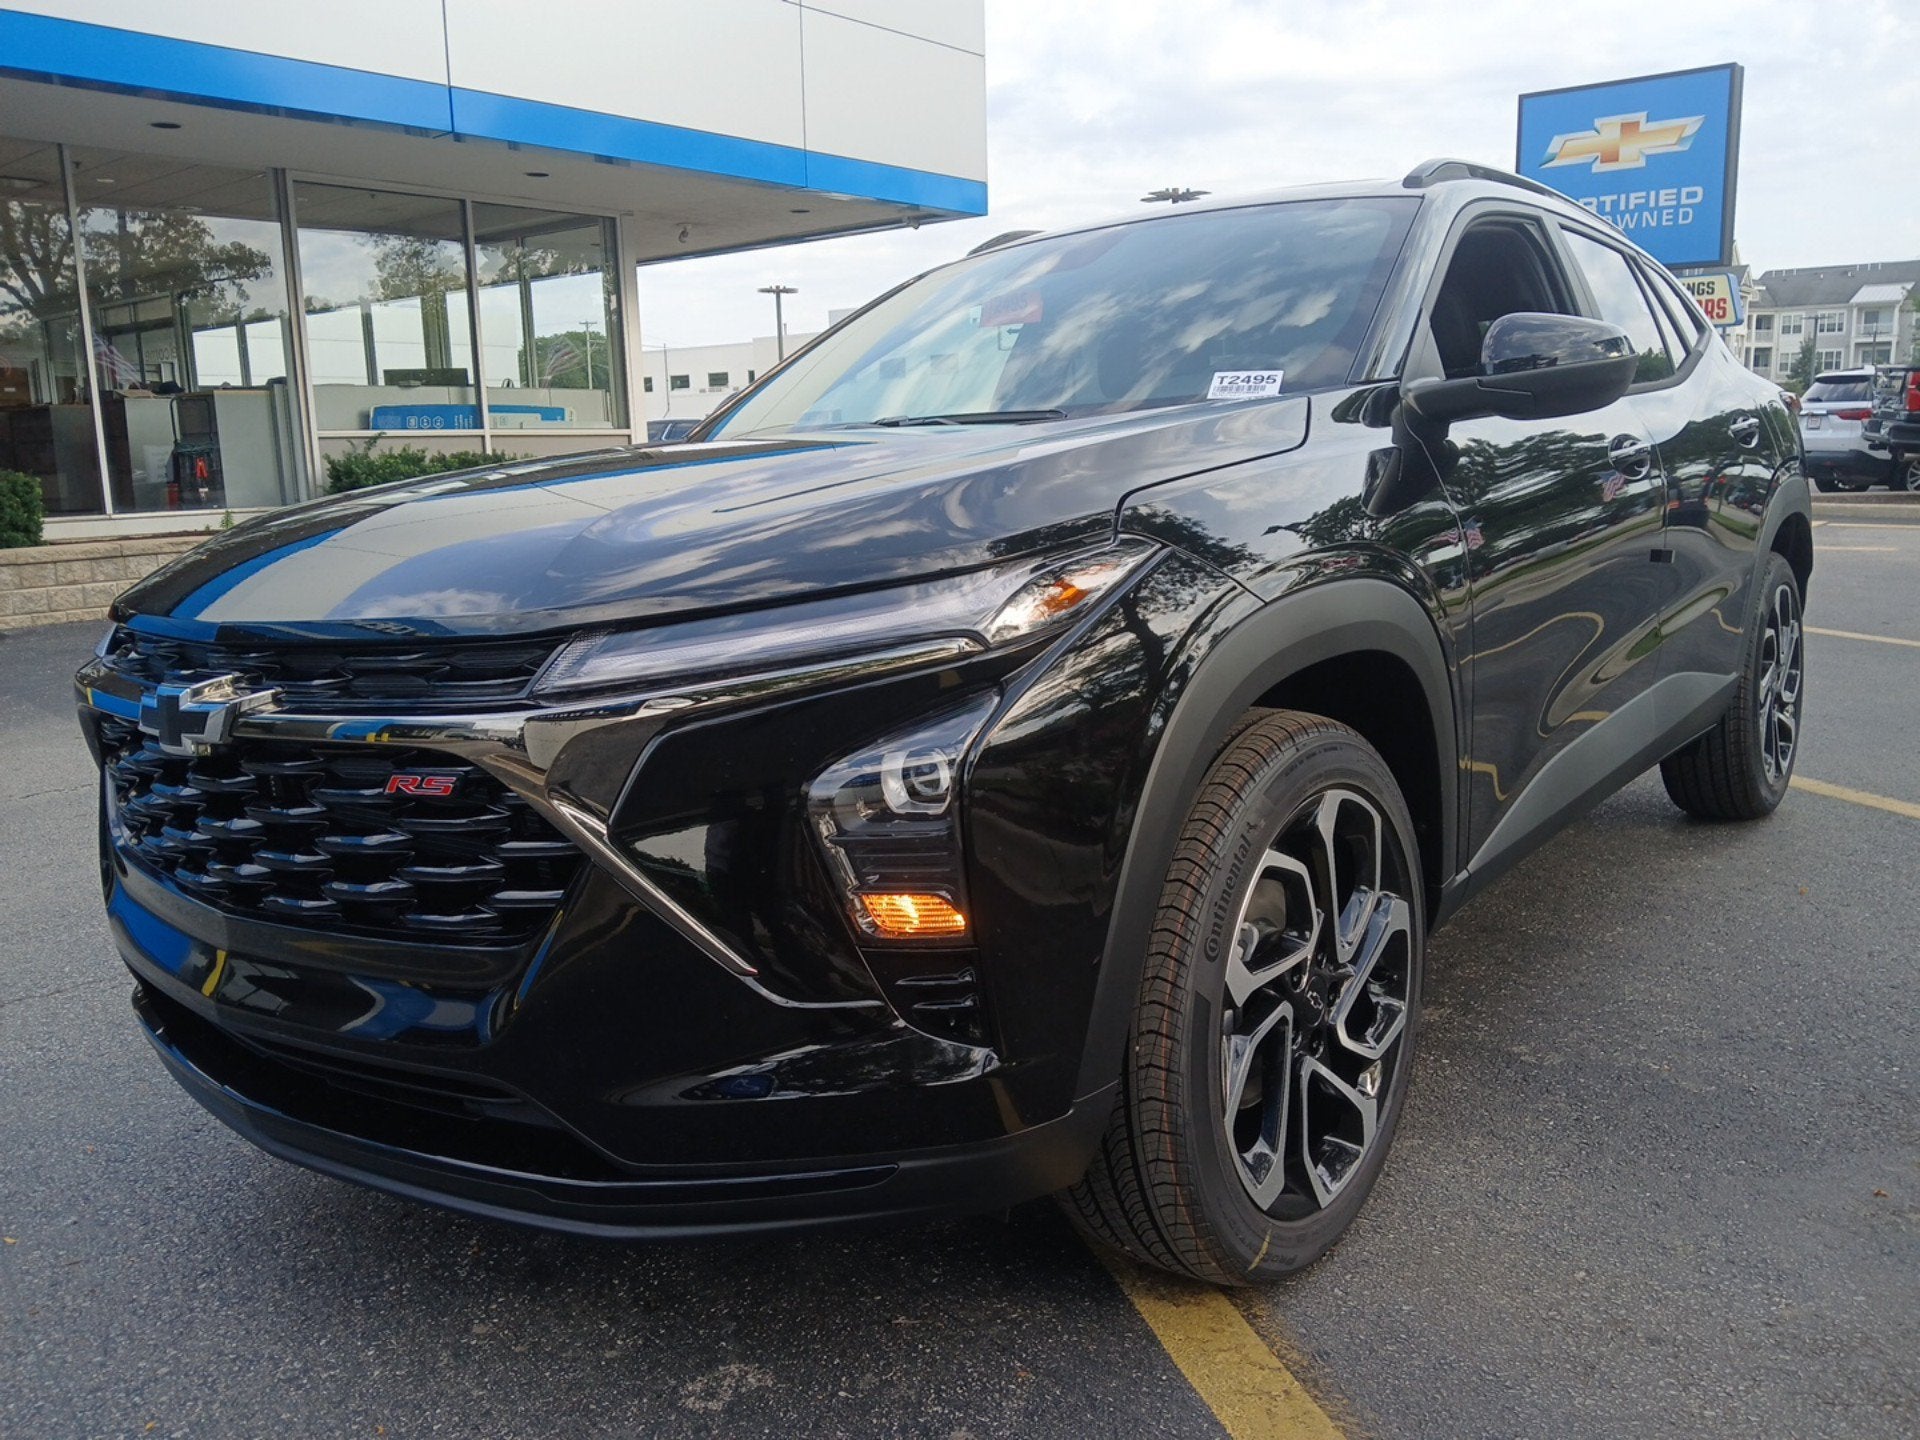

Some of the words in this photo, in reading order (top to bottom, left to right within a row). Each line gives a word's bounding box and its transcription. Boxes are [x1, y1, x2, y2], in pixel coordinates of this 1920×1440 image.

[1217, 374, 1279, 385] T2495
[386, 774, 456, 796] RS
[1204, 836, 1251, 963] Continental
